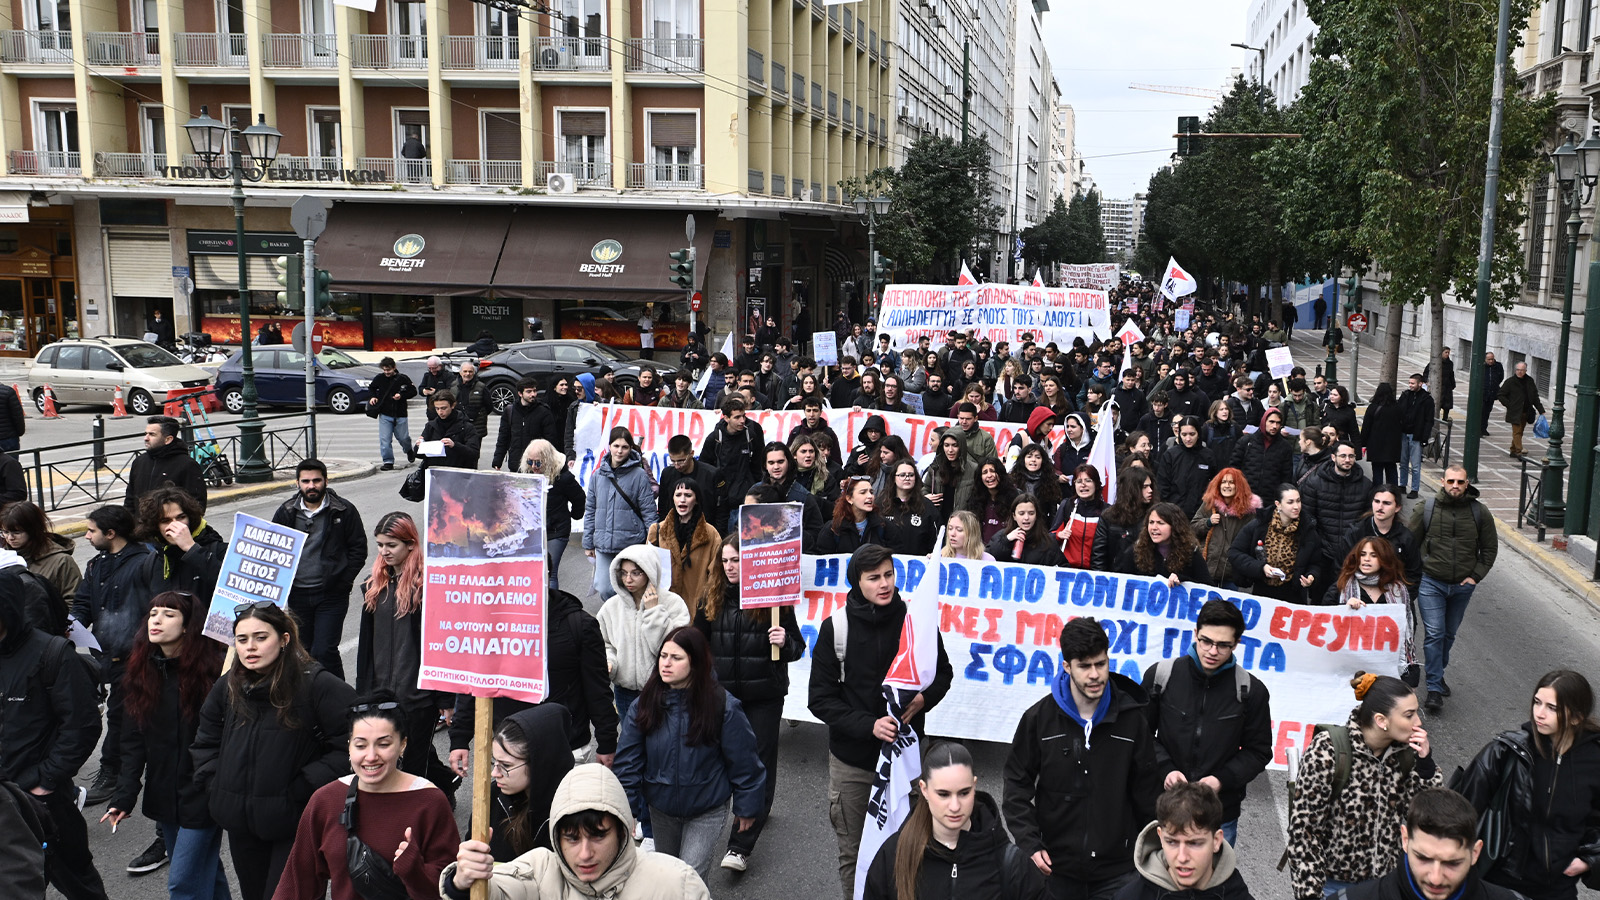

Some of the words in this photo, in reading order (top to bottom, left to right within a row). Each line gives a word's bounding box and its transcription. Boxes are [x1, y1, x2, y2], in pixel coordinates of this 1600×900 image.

[268, 168, 386, 182] ΕΣΩΤΕΡΙΚΩΝ
[380, 258, 425, 268] BENETH
[579, 263, 625, 273] BENETH
[882, 290, 946, 307] ΑΠΕΜΠΛΟΚΗ
[953, 291, 971, 307] ΤΗΣ
[976, 288, 1019, 305] ΕΛΛΑΔΑΣ
[1023, 290, 1042, 306] ΑΠΟ
[1047, 292, 1066, 307] ΤΟΝ
[1069, 292, 1106, 311] ΠΟΛΕΜΟ!
[472, 305, 510, 315] BENETH
[886, 309, 956, 327] ΑΛΛΗΛΕΓΓΥΗ
[961, 308, 974, 325] ΣΕ
[1012, 308, 1035, 325] ΤΟΥΣ
[1043, 310, 1075, 327] ΛΑΟΥΣ
[905, 329, 957, 344] ΦΟΙΤΗΤΙΚ
[601, 406, 704, 451] ΚΑΜΙΑ
[243, 525, 294, 550] ΚΑΝΕΝΑΣ
[236, 541, 294, 568] ΦΑΝΤΑΡΟΣ
[752, 559, 766, 567] ΤΟΝ
[768, 555, 798, 565] ΠΟΛΕΜΟ!
[240, 560, 277, 581] ΕΚΤΟΣ
[429, 573, 446, 584] ΕΞΩ
[449, 574, 456, 585] Η
[459, 575, 505, 587] ΕΛΛΑΔΑ
[507, 576, 531, 587] ΑΠΟ
[227, 574, 281, 600] ΣΥΝΟΡΩΝ
[753, 575, 799, 590] ΘΑΝΑΤΟΥ!
[445, 591, 472, 604] ΤΟΝ
[473, 592, 537, 606] ΠΟΛΕΜΟ!
[815, 557, 839, 587] Η
[978, 565, 1046, 604] ΑΠΟ
[1055, 571, 1118, 608] ΤΟΝ
[1121, 578, 1262, 631] ΠΟΛΕΟ
[1269, 605, 1399, 653] ΕΡΕΥΝΑ
[439, 620, 452, 631] ΝΑ
[454, 621, 492, 632] ΦΥΓΟΥΝ
[496, 622, 509, 632] ΟΙ
[510, 624, 540, 634] ΒΑΣΕΙΣ
[1015, 609, 1080, 649] ΜΑ
[429, 642, 444, 651] ΤΟΥ
[445, 635, 540, 657] ΘΑΝΑΤΟΥ!
[423, 669, 469, 683] ΦΟΙΤΗΤΙΚΟΙ
[469, 675, 508, 687] ΣΥΛΛΟΓΟΙ
[509, 680, 543, 691] ΑΘΗΝΑΣ
